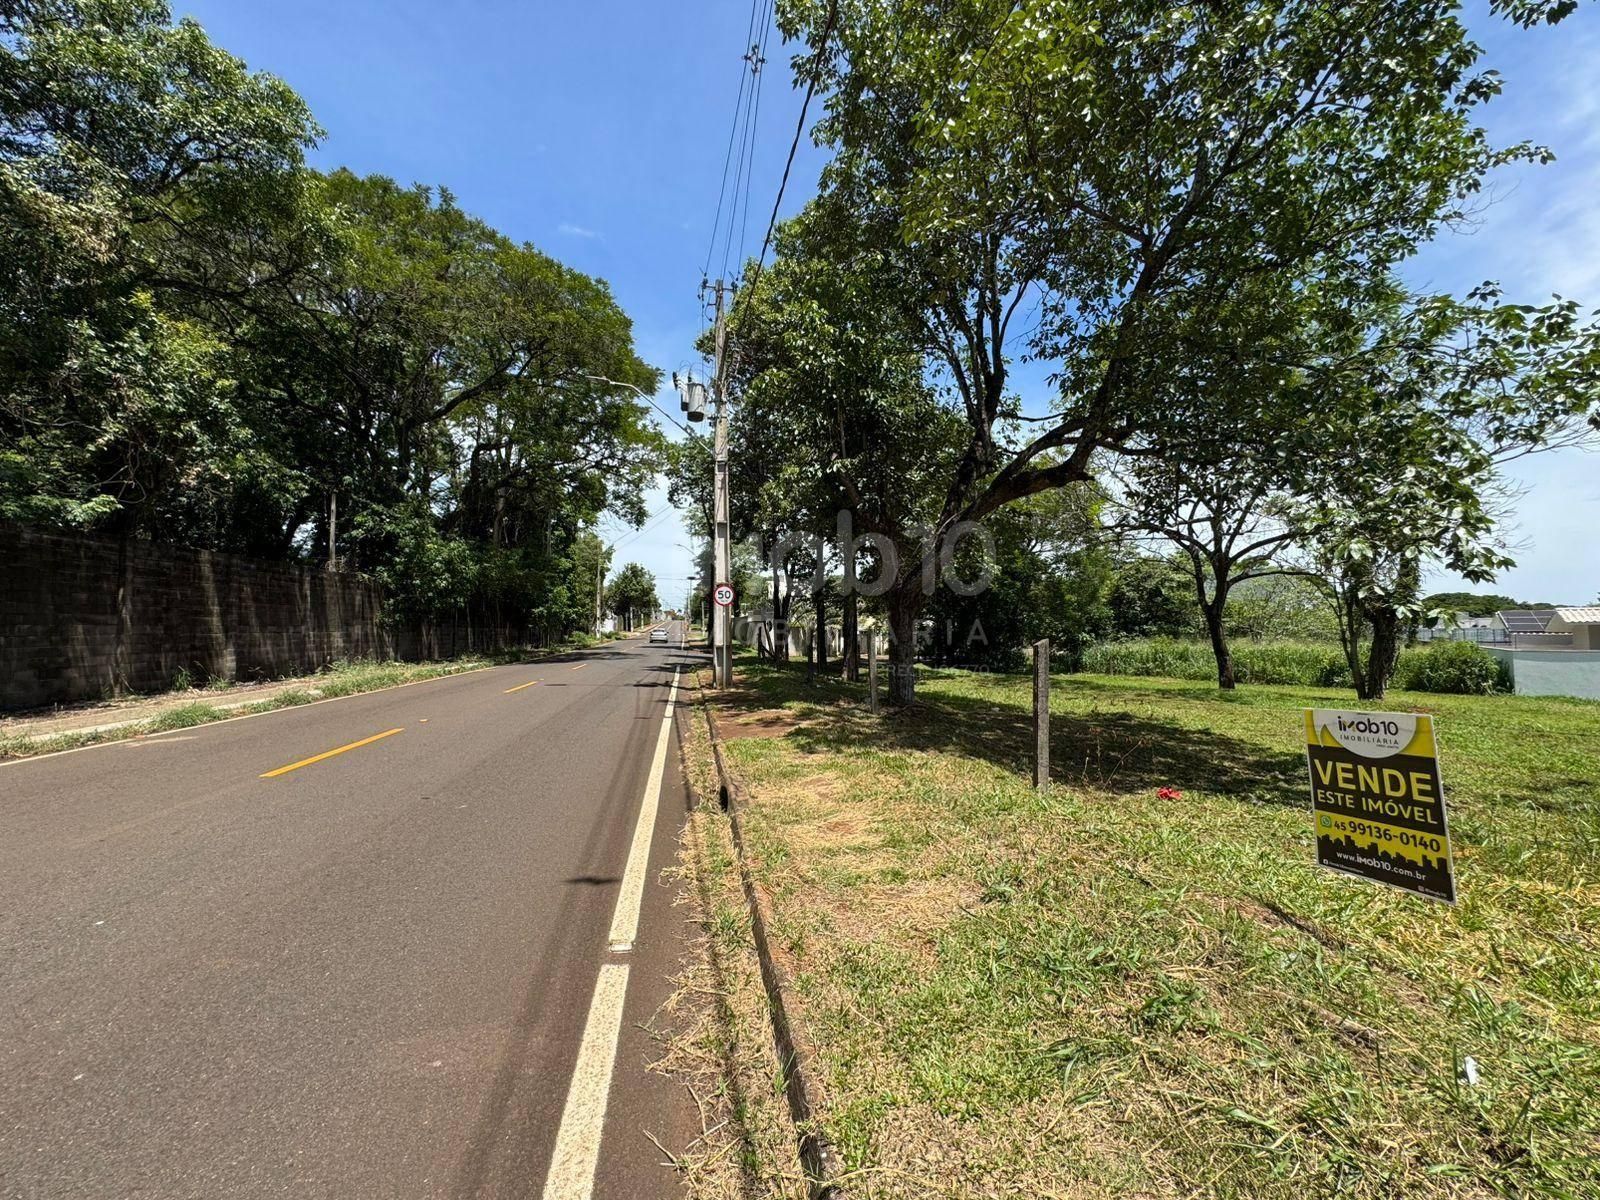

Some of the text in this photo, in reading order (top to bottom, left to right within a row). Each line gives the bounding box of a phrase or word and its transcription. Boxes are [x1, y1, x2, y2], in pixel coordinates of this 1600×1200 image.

[717, 590, 731, 600] 50
[1340, 734, 1399, 745] IMOBILIÁRIA
[1313, 759, 1436, 804] VENDE
[1317, 789, 1439, 825] ESTE IMÓVEL
[1334, 820, 1441, 853] 45 99136-0140
